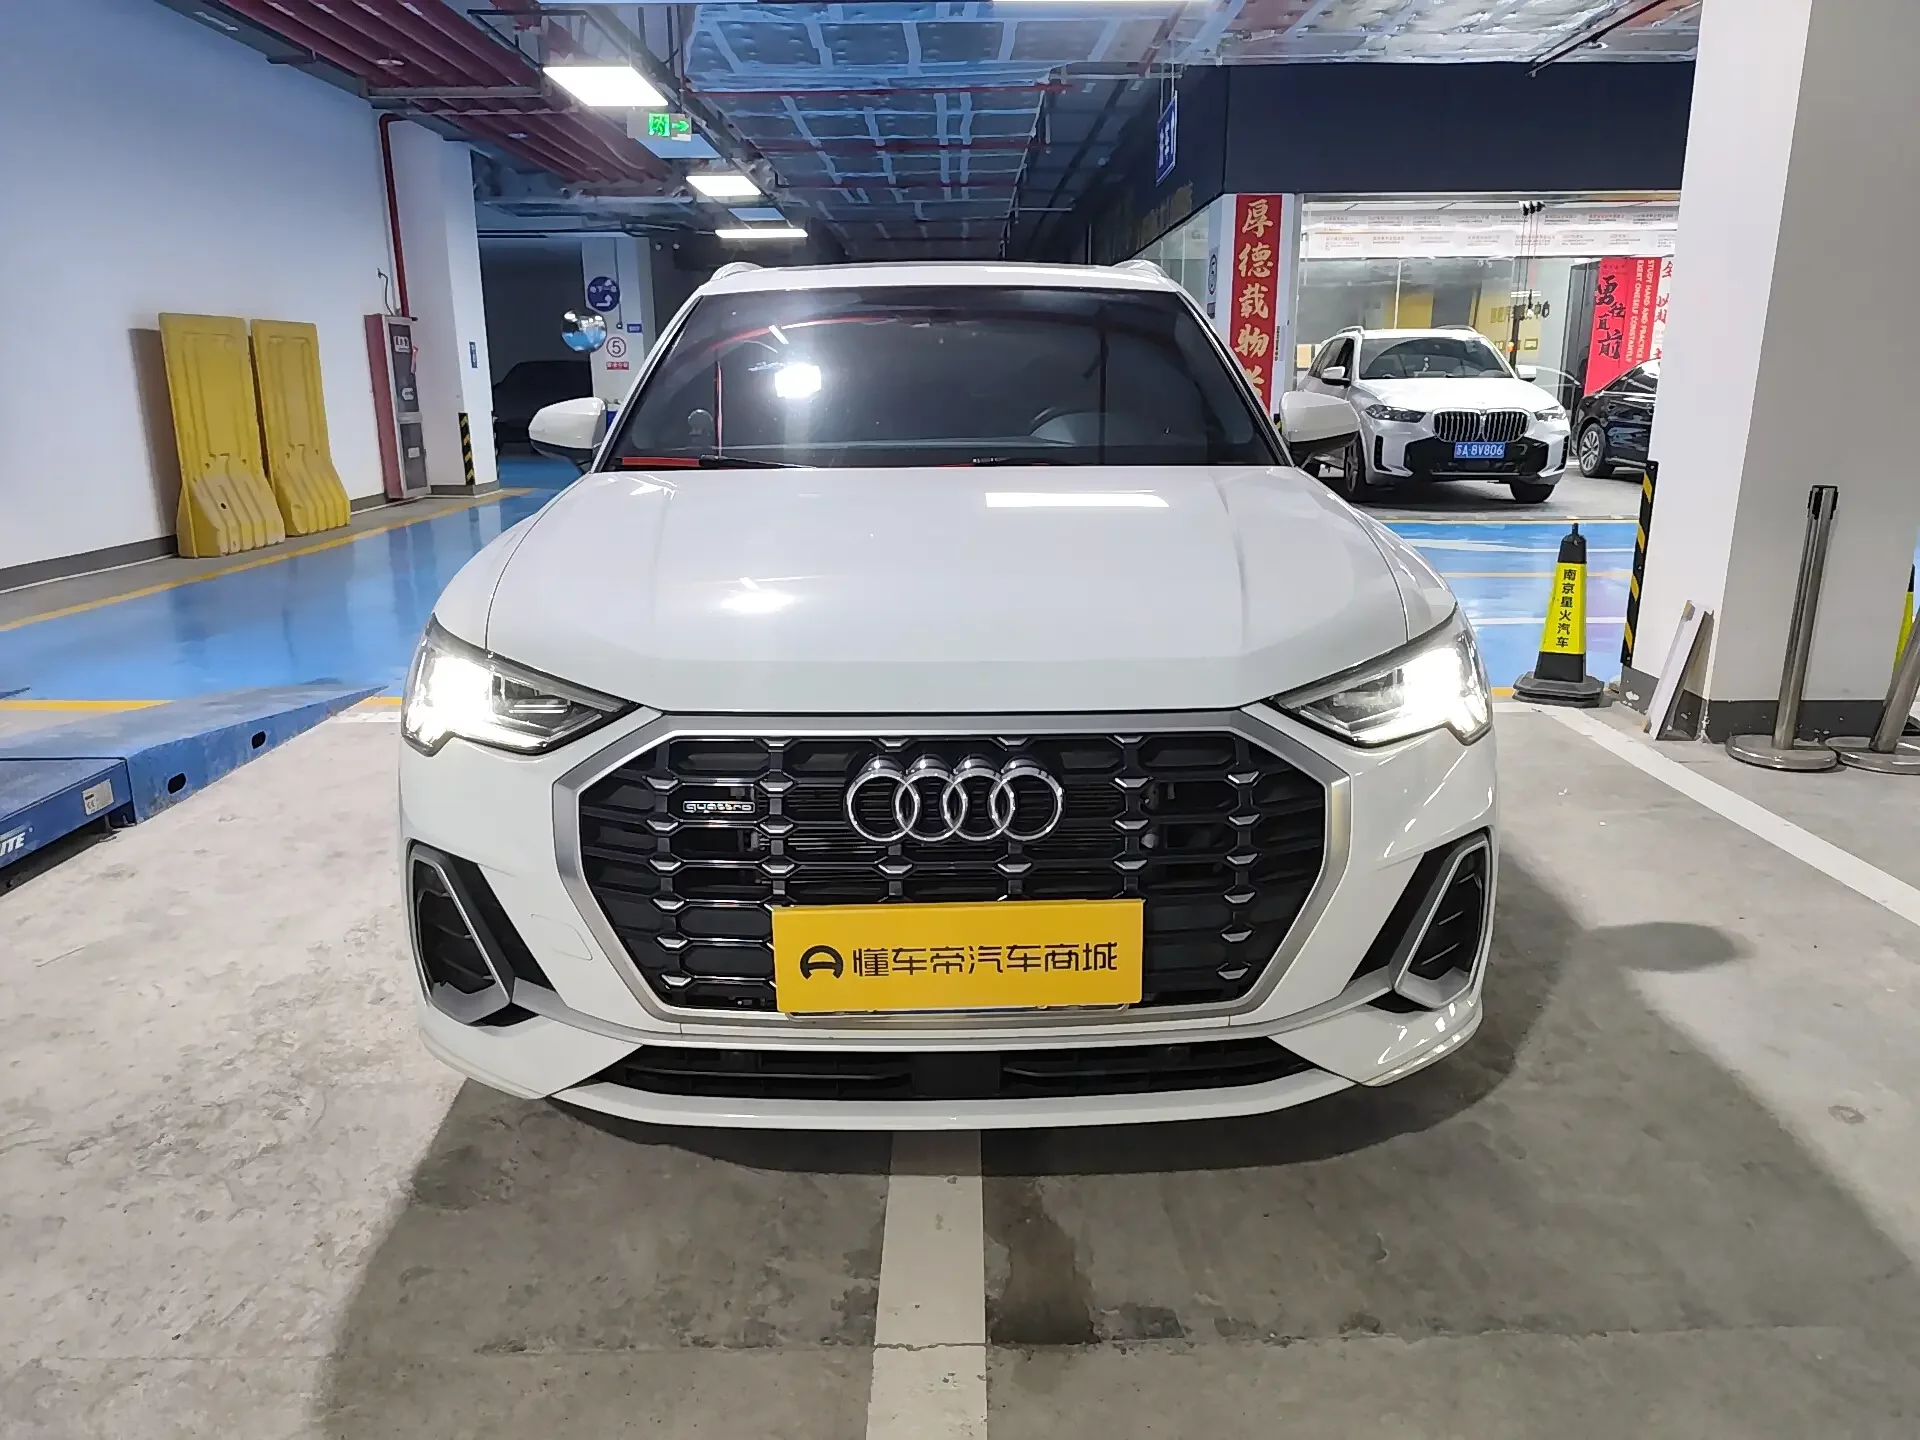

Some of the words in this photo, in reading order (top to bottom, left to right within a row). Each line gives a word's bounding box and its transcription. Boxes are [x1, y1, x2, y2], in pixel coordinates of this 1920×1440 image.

[1595, 274, 1626, 359] 勇往直前
[1556, 569, 1577, 648] 南京星火汽车
[686, 803, 752, 813] quattro
[852, 941, 1118, 978] 懂车帝汽车商城
